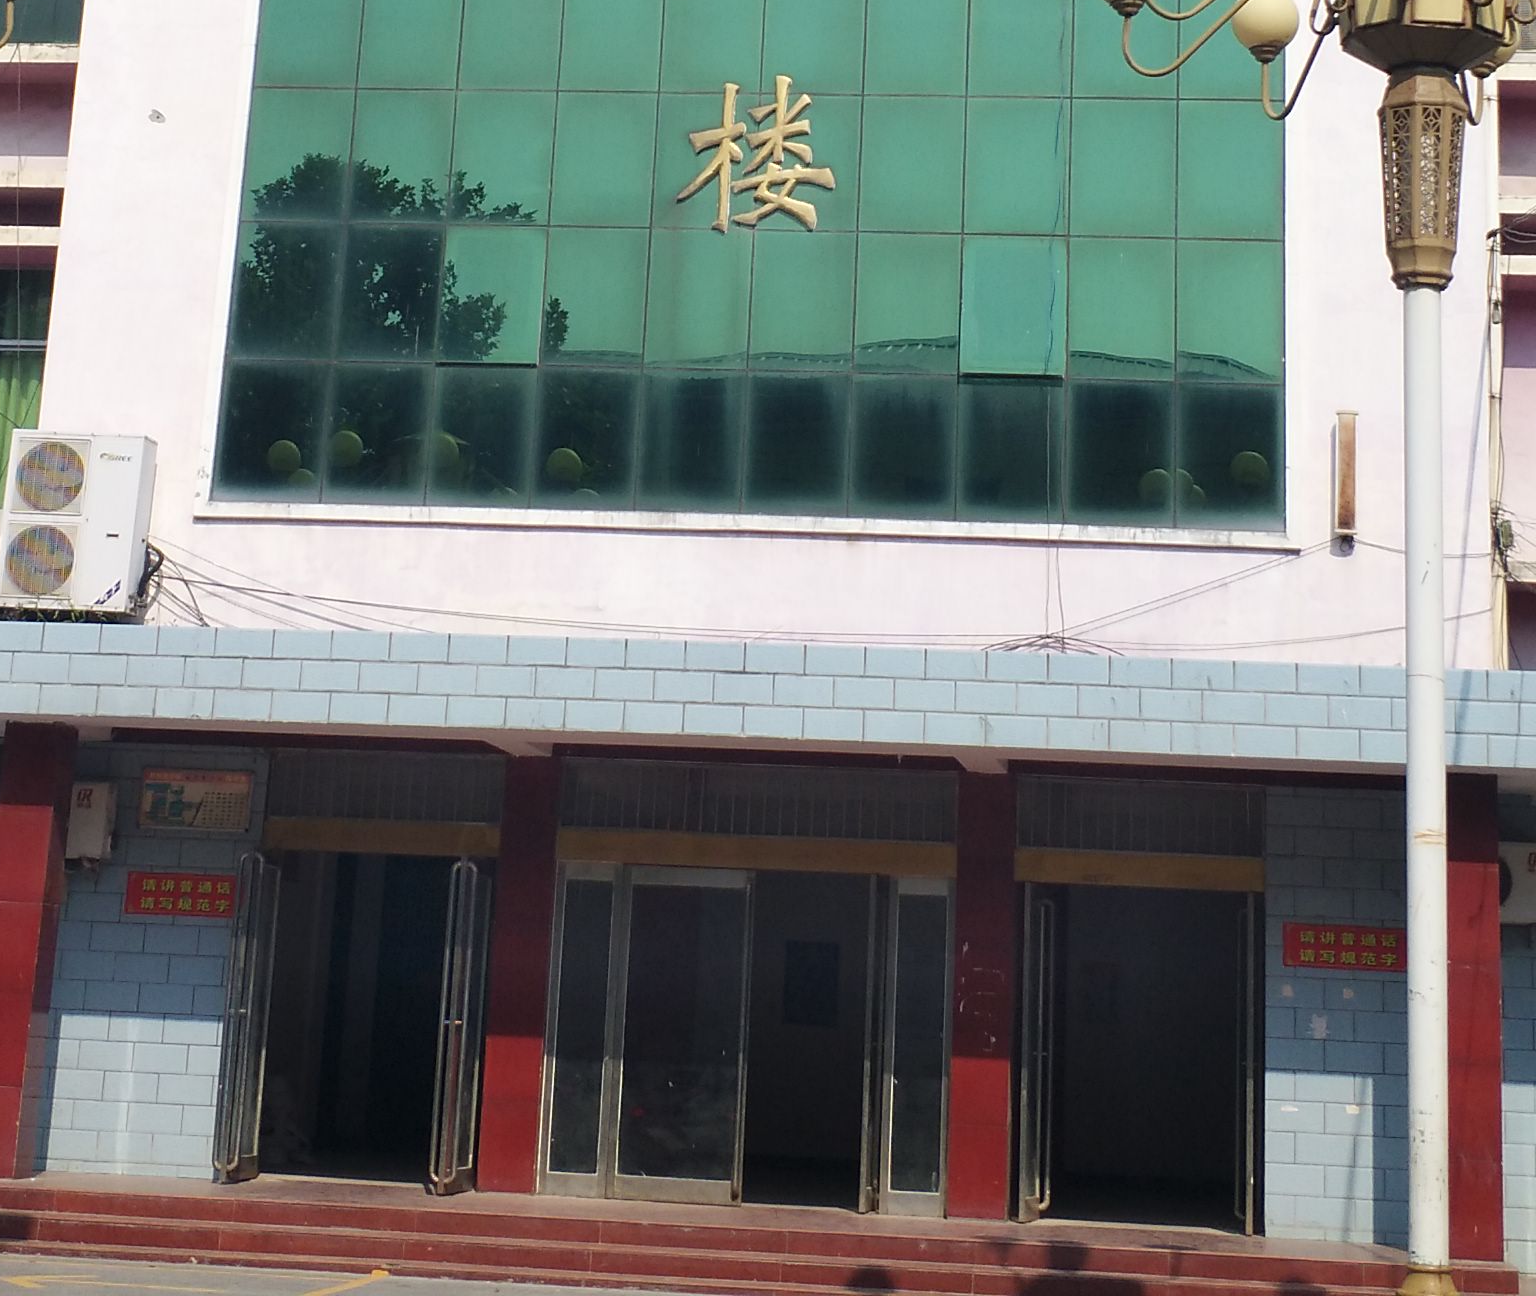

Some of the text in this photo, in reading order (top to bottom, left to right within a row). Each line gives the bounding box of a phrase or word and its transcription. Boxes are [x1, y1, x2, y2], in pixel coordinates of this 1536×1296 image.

[142, 878, 231, 894] 请讲普通话
[140, 896, 230, 912] 请写规范字
[1300, 930, 1399, 948] 请讲普通话
[1300, 948, 1399, 967] 请写规范字
